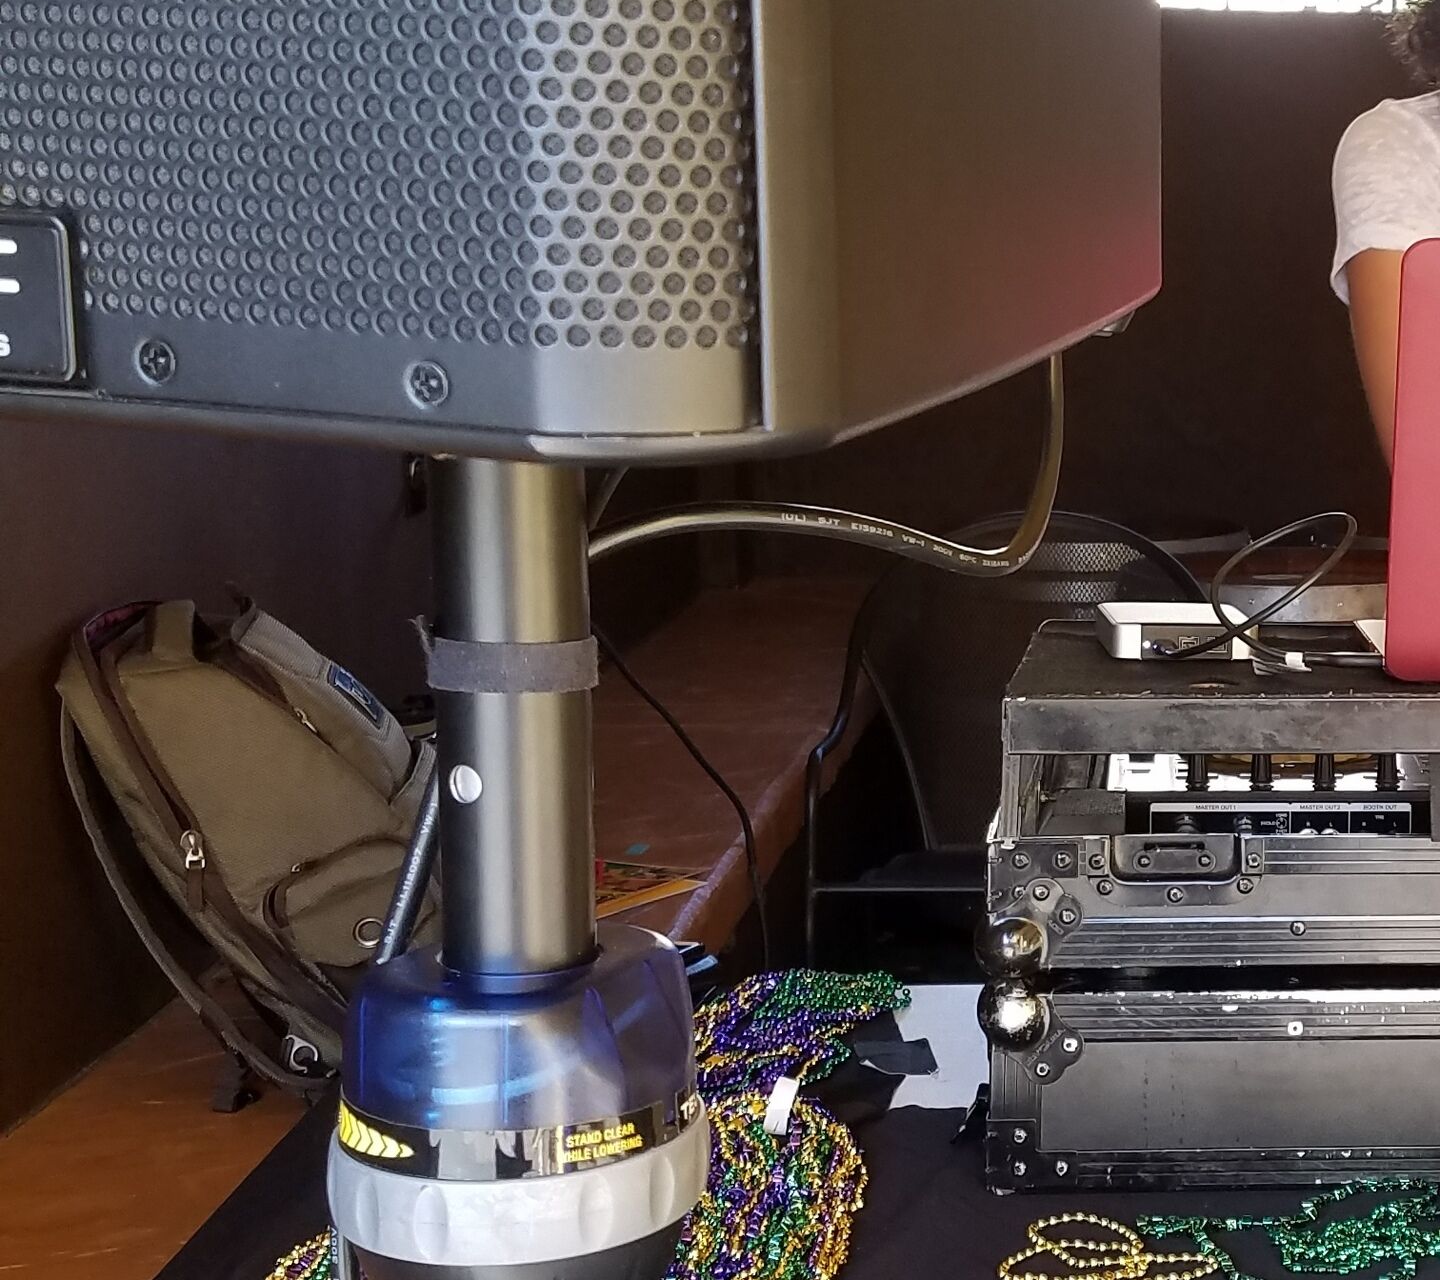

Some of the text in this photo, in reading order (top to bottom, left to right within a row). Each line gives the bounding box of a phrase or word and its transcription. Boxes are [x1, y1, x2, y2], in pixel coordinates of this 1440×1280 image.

[565, 1122, 636, 1149] STAND CLEAR
[592, 1133, 645, 1159] LOWERING
